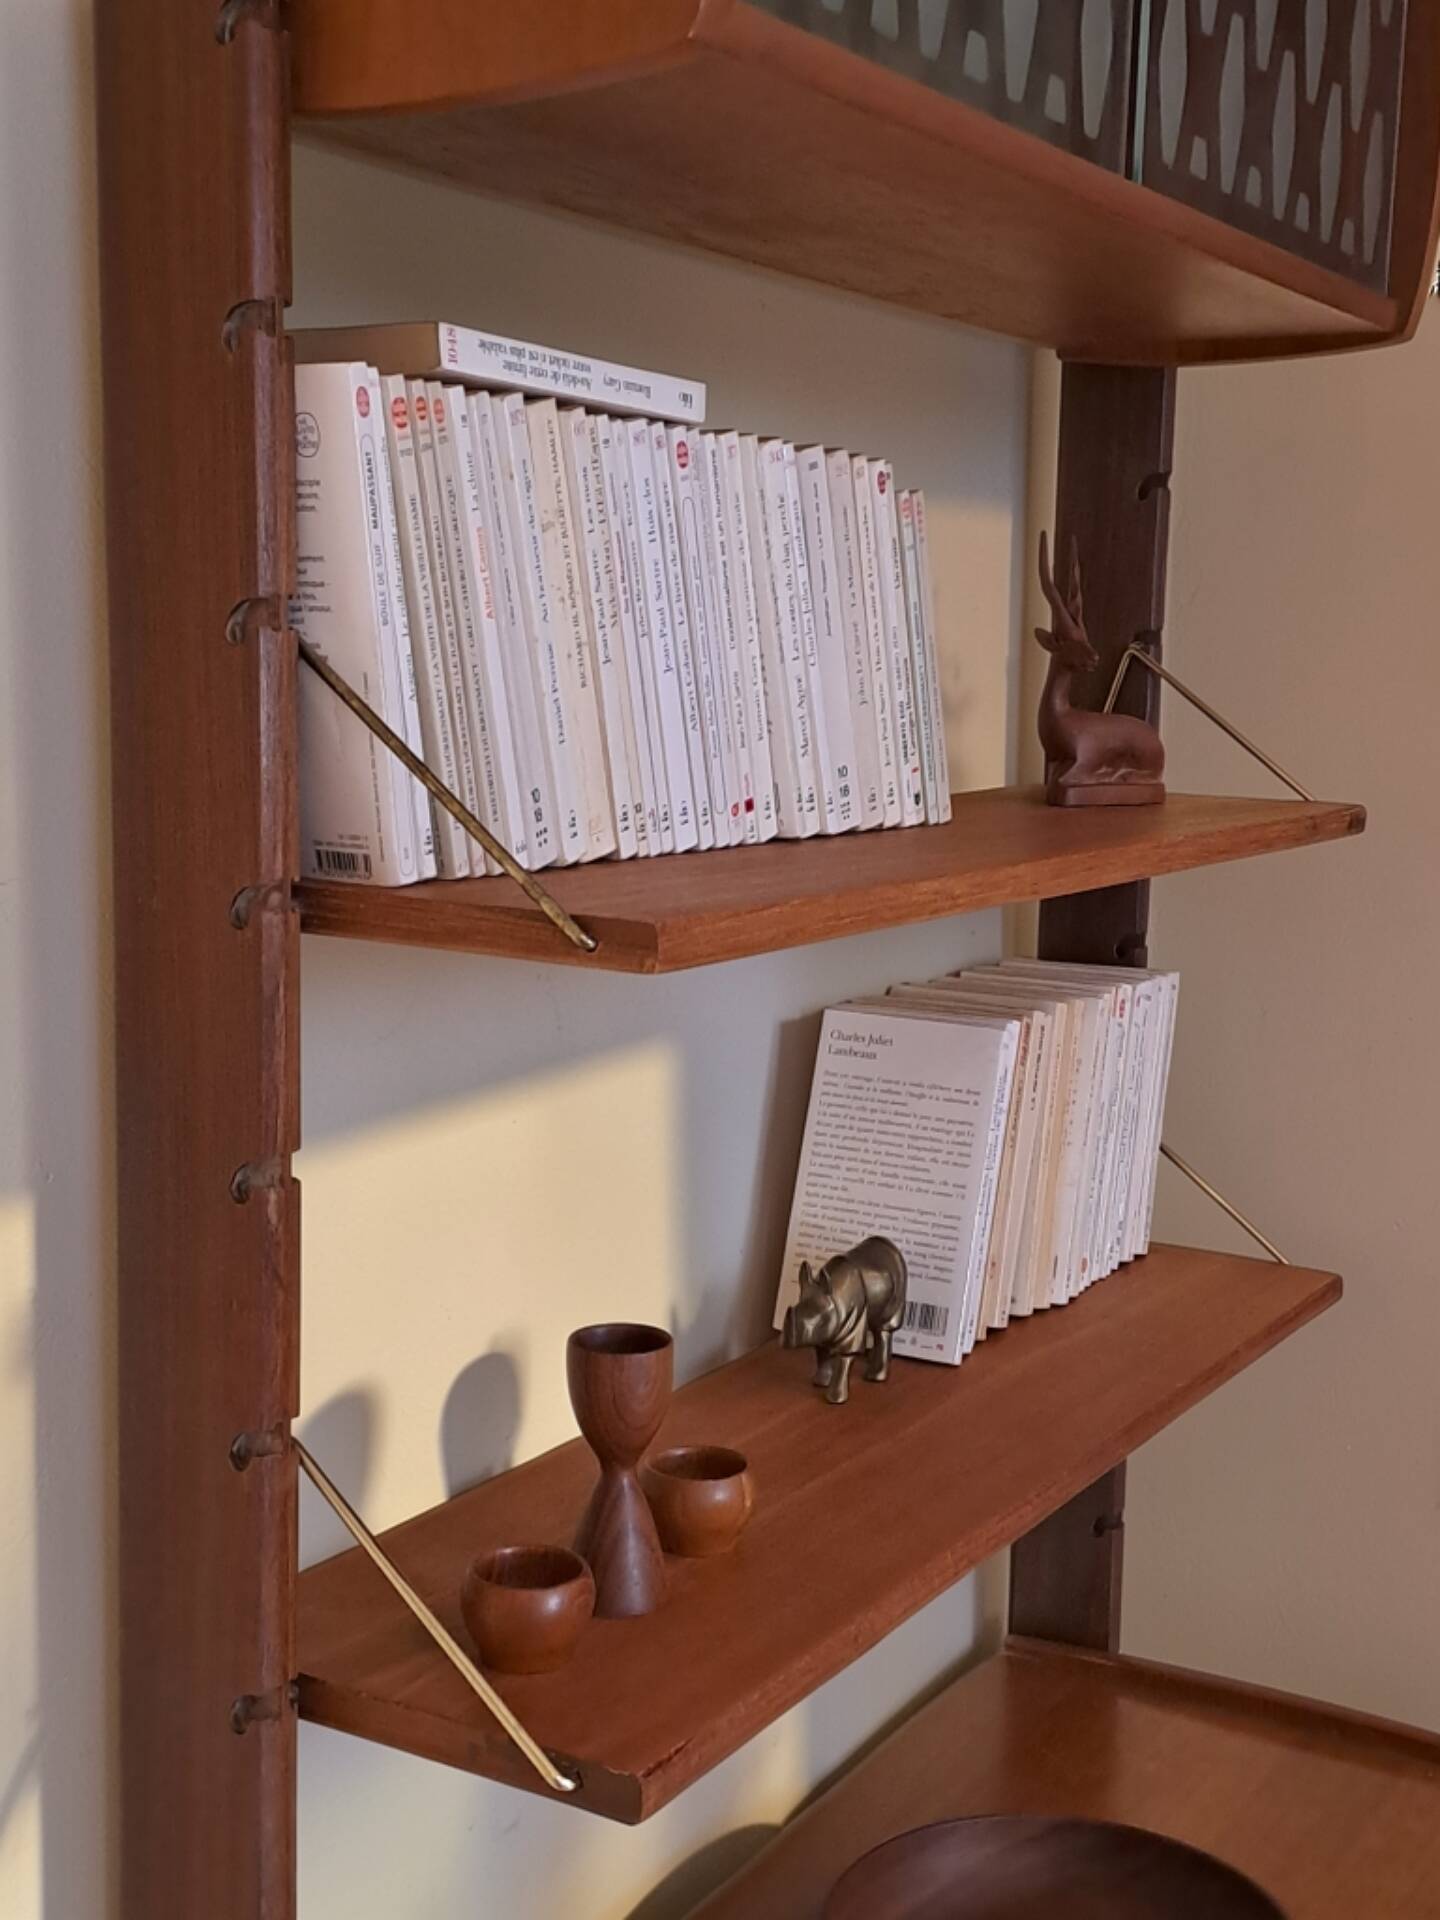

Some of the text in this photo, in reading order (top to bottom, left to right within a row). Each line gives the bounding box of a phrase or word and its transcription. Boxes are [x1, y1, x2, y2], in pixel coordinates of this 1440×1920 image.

[478, 339, 508, 359] valable
[509, 345, 526, 362] plus
[502, 360, 528, 377] limite
[550, 370, 561, 382] de
[602, 375, 651, 399] Romain Gary
[547, 418, 559, 474] HAMLET
[466, 452, 477, 490] chute
[521, 459, 532, 500] ogres
[581, 466, 591, 503] mots
[710, 449, 722, 518] humanisme
[445, 476, 460, 541] GRECQUE
[471, 494, 479, 512] La
[622, 481, 634, 527] Knock
[642, 478, 652, 506] clos
[661, 480, 672, 518] mère
[409, 493, 422, 532] DAME
[527, 504, 536, 530] des
[586, 508, 595, 534] Les
[646, 510, 657, 544] Huis
[716, 520, 724, 537] un
[777, 494, 790, 537] perché
[365, 451, 390, 626] BOULE DE SUIF MAUPASSANT
[432, 515, 447, 582] BOURREAU
[475, 527, 488, 573] Camus
[562, 544, 571, 559] ET
[665, 522, 675, 545] ma
[792, 499, 806, 568] Lambeaux
[414, 535, 428, 581] VIEILLE
[532, 535, 547, 599] bonheur
[590, 549, 602, 593] Sartre
[629, 540, 643, 603] Romains
[669, 551, 678, 567] de
[782, 543, 791, 569] chat
[845, 545, 856, 588] Maison
[420, 583, 430, 600] LA
[652, 558, 664, 601] Sartre
[673, 573, 683, 603] livre
[785, 574, 793, 591] du
[800, 580, 815, 614] Juliet
[423, 603, 433, 620] DE
[481, 577, 495, 620] Albert
[541, 602, 550, 624] Au
[676, 608, 685, 626] Le
[787, 595, 798, 635] contes
[849, 591, 857, 608] La
[426, 622, 439, 659] VISITE
[464, 613, 476, 648] GREC
[596, 598, 612, 665] Jean-Paul
[637, 606, 648, 639] Jules
[655, 607, 673, 674] Jean-Paul
[852, 621, 861, 656] Carré
[448, 629, 458, 659] JUGE
[574, 631, 588, 688] RICHARD
[791, 638, 800, 661] Les
[804, 618, 816, 667] Charles
[405, 654, 416, 702] Aragon
[433, 661, 442, 680] LA
[451, 661, 460, 677] LE
[546, 641, 559, 693] Pennac
[681, 639, 693, 687] Cohen
[749, 655, 760, 686] Gary
[855, 659, 863, 674] Le
[472, 663, 490, 752] DÜRRENMATT
[793, 674, 805, 710] Aymé
[857, 677, 868, 706] John
[437, 688, 453, 767] DÜRRENMATT
[553, 699, 566, 745] Daniel
[685, 690, 698, 732] Albert
[751, 690, 764, 741] Romain
[796, 714, 809, 758] Marcel
[484, 754, 499, 823] FRIEDRICH
[828, 1044, 878, 1060] Lambeaux
[830, 1029, 893, 1047] Charles Juliet
